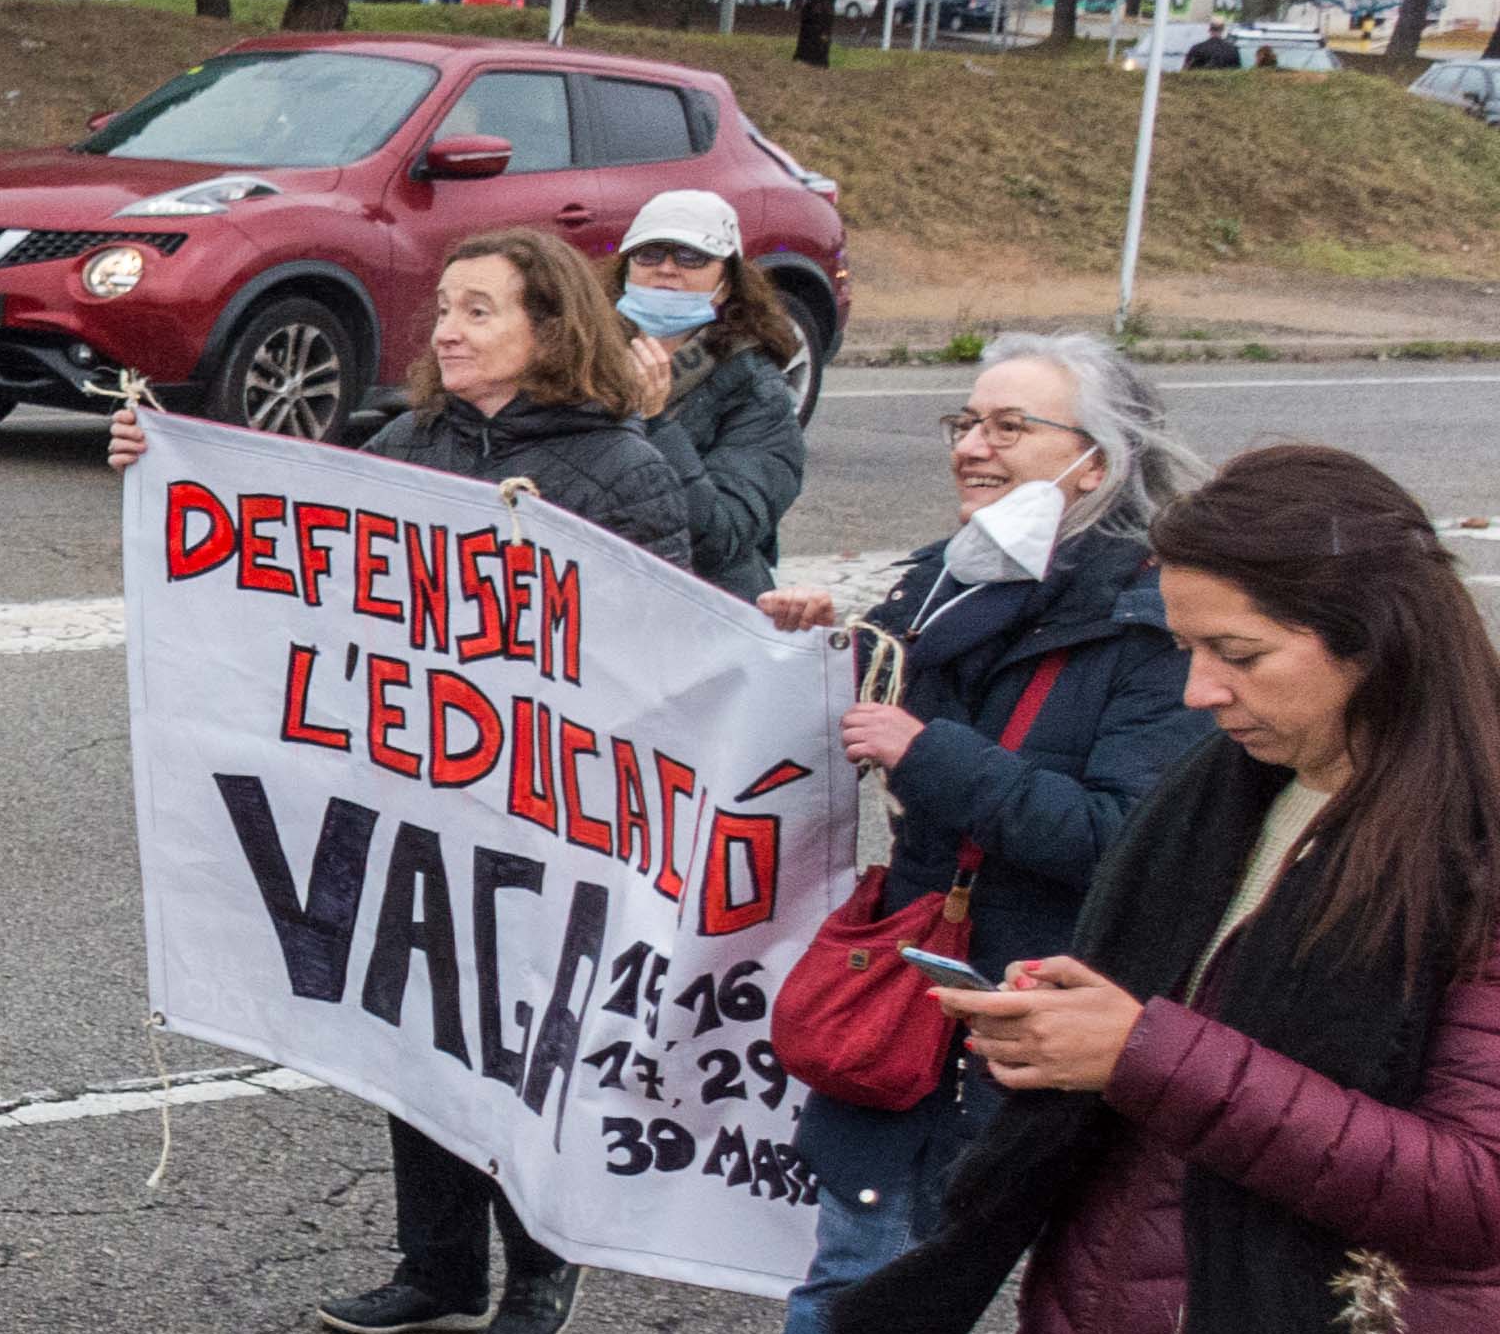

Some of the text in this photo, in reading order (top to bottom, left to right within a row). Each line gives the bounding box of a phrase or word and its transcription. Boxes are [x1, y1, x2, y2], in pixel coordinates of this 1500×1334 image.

[164, 479, 583, 688] DEFENSEM
[211, 770, 610, 1154] VAGA
[601, 1115, 697, 1176] 30
